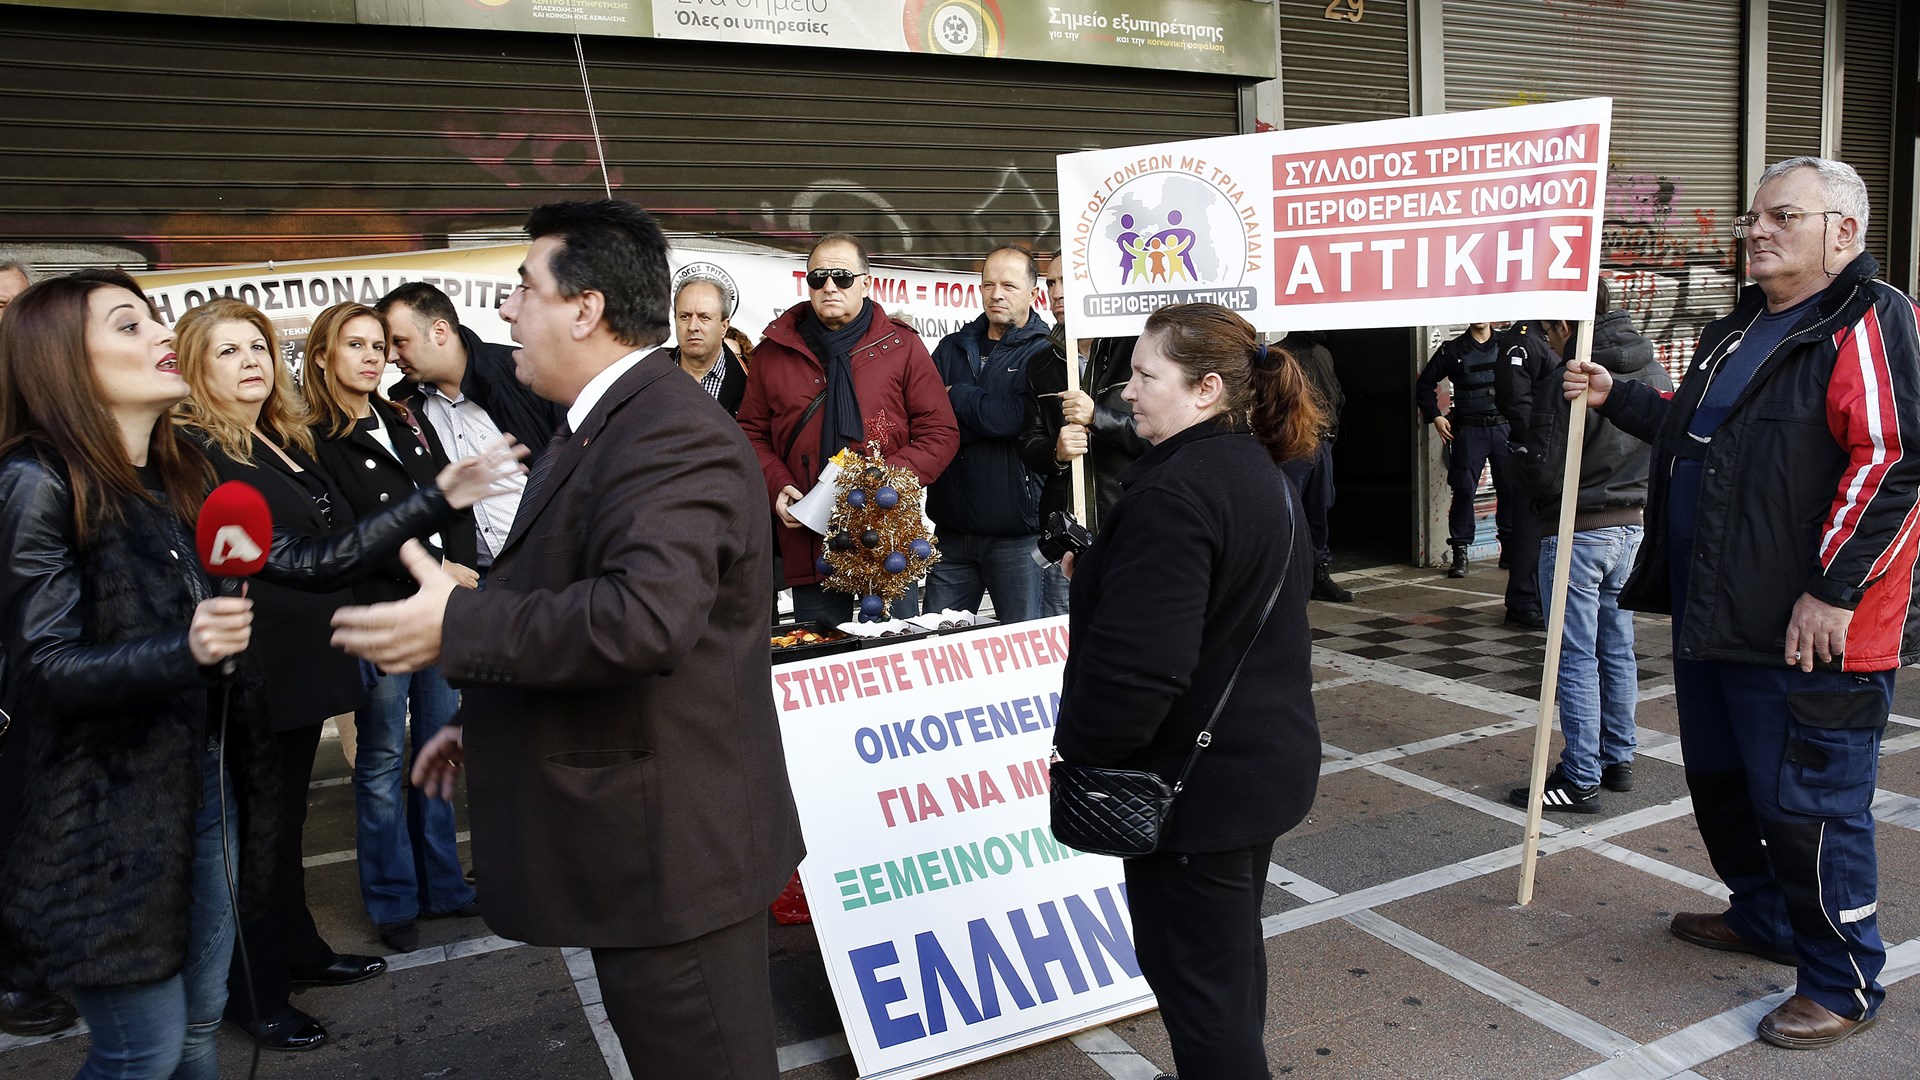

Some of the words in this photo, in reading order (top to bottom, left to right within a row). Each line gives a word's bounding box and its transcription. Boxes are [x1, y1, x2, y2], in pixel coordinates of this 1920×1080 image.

[675, 10, 720, 29] Όλες
[723, 16, 740, 28] οι
[743, 18, 829, 36] υπηρεσίες
[1047, 6, 1108, 31] Σημείο
[1112, 13, 1224, 42] εξυπηρέτησης
[1324, 0, 1364, 22] 29
[1049, 30, 1063, 40] για
[1064, 31, 1080, 42] την
[1116, 36, 1129, 44] και
[1130, 37, 1145, 48] την
[1147, 38, 1186, 50] κοινωνική
[1187, 42, 1225, 53] ασφάλιση
[1285, 150, 1418, 186] ΣΥΛΛΟΓΟΣ
[1424, 133, 1586, 174] ΤΡΙΤΕΚΝΩΝ
[1072, 190, 1107, 281] ΣΥΛΛΟΓΟΣ
[1104, 154, 1172, 192] ΓΟΝΕΩΝ
[1180, 155, 1206, 175] ΜΕ
[1211, 166, 1245, 205] ΤΡΙΑ
[1240, 206, 1262, 273] ΠΑΙΔΙΑ
[1287, 189, 1462, 226] ΠΕΡΙΦΕΡΕΙΑΣ
[1471, 176, 1588, 216] (ΝΟΜΟΥ)
[1284, 225, 1584, 296] ΑΤΤΙΚΗΣ
[184, 276, 408, 312] ΟΟΣΠΟΝΔΙ
[422, 275, 520, 310] ΡΙΤΕ
[281, 326, 311, 336] ΤΕΚΝ
[774, 652, 913, 712] ΣΤΗΡΙΞΤΕ
[911, 642, 974, 686] ΤΗΝ
[876, 782, 945, 828] ΓΙΑ
[945, 770, 1006, 813] ΝΑ
[833, 824, 1085, 911] ΞΕΜΕΙΝΟΥΜ
[847, 882, 1144, 1050] ΕΛΛΗΝ
